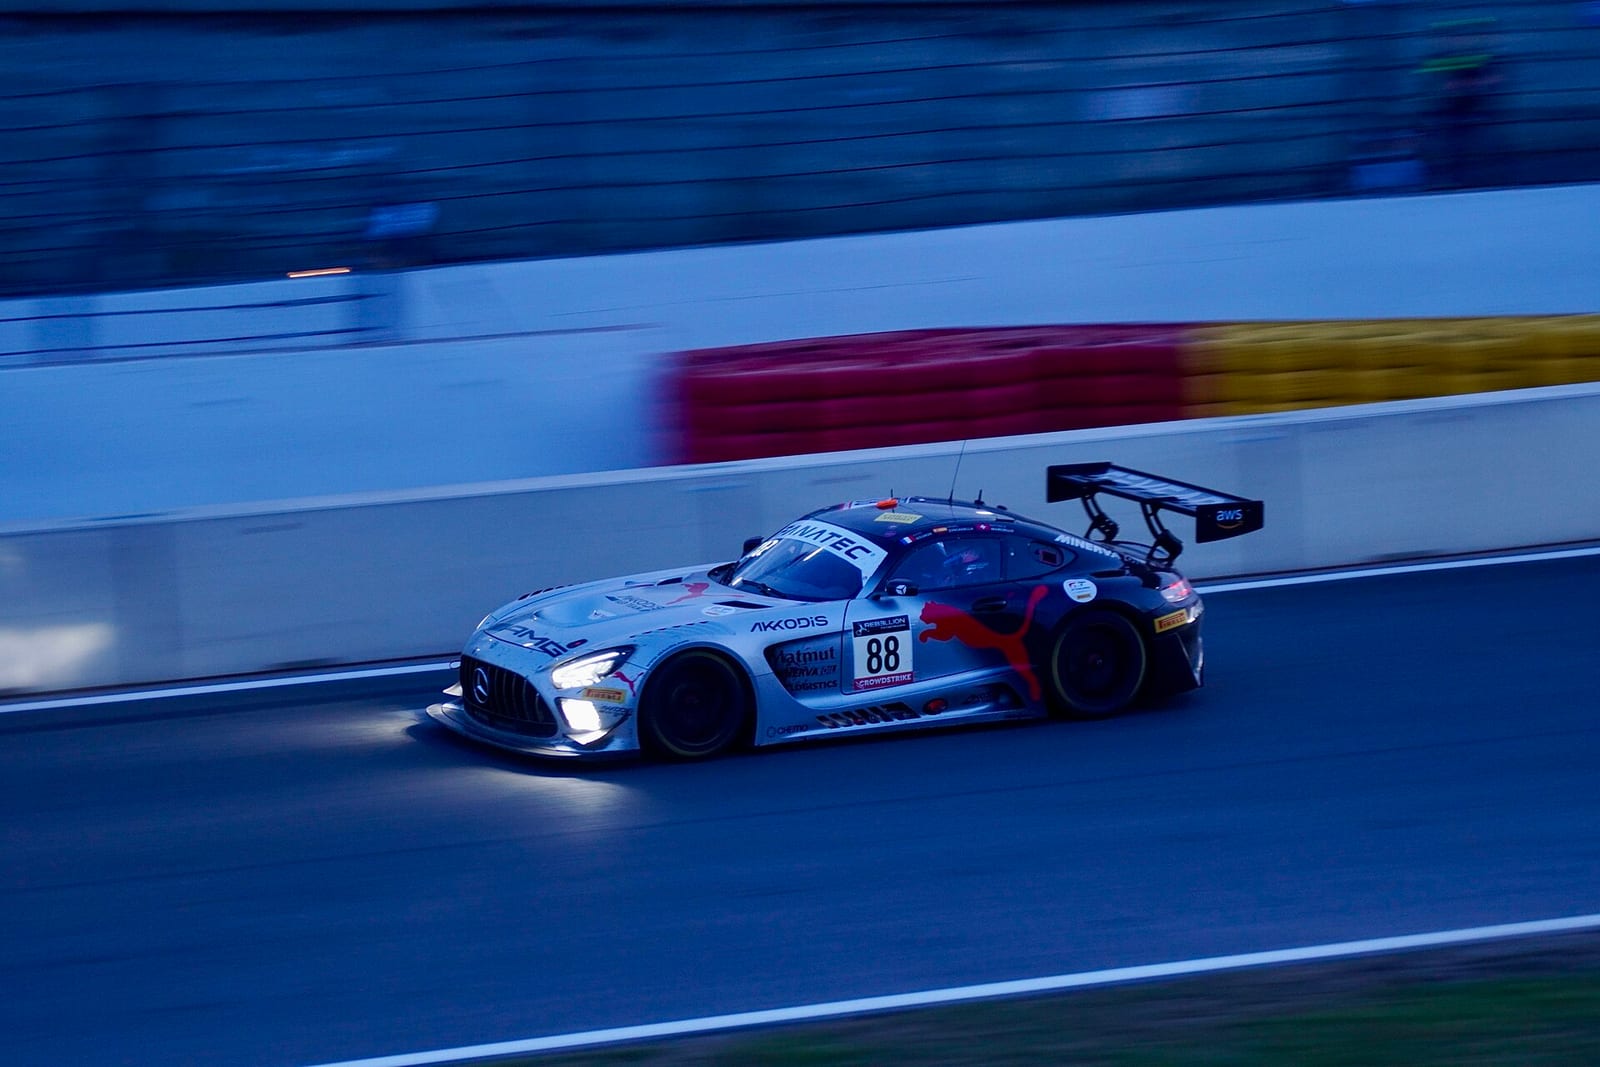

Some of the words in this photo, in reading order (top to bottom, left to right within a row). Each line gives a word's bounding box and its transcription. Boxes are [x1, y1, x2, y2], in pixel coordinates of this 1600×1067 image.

[1216, 509, 1243, 521] aws
[1055, 534, 1122, 560] MINERVA
[506, 625, 568, 658] AMG
[867, 636, 900, 674] 88
[859, 674, 912, 687] CROWDSTRIKE
